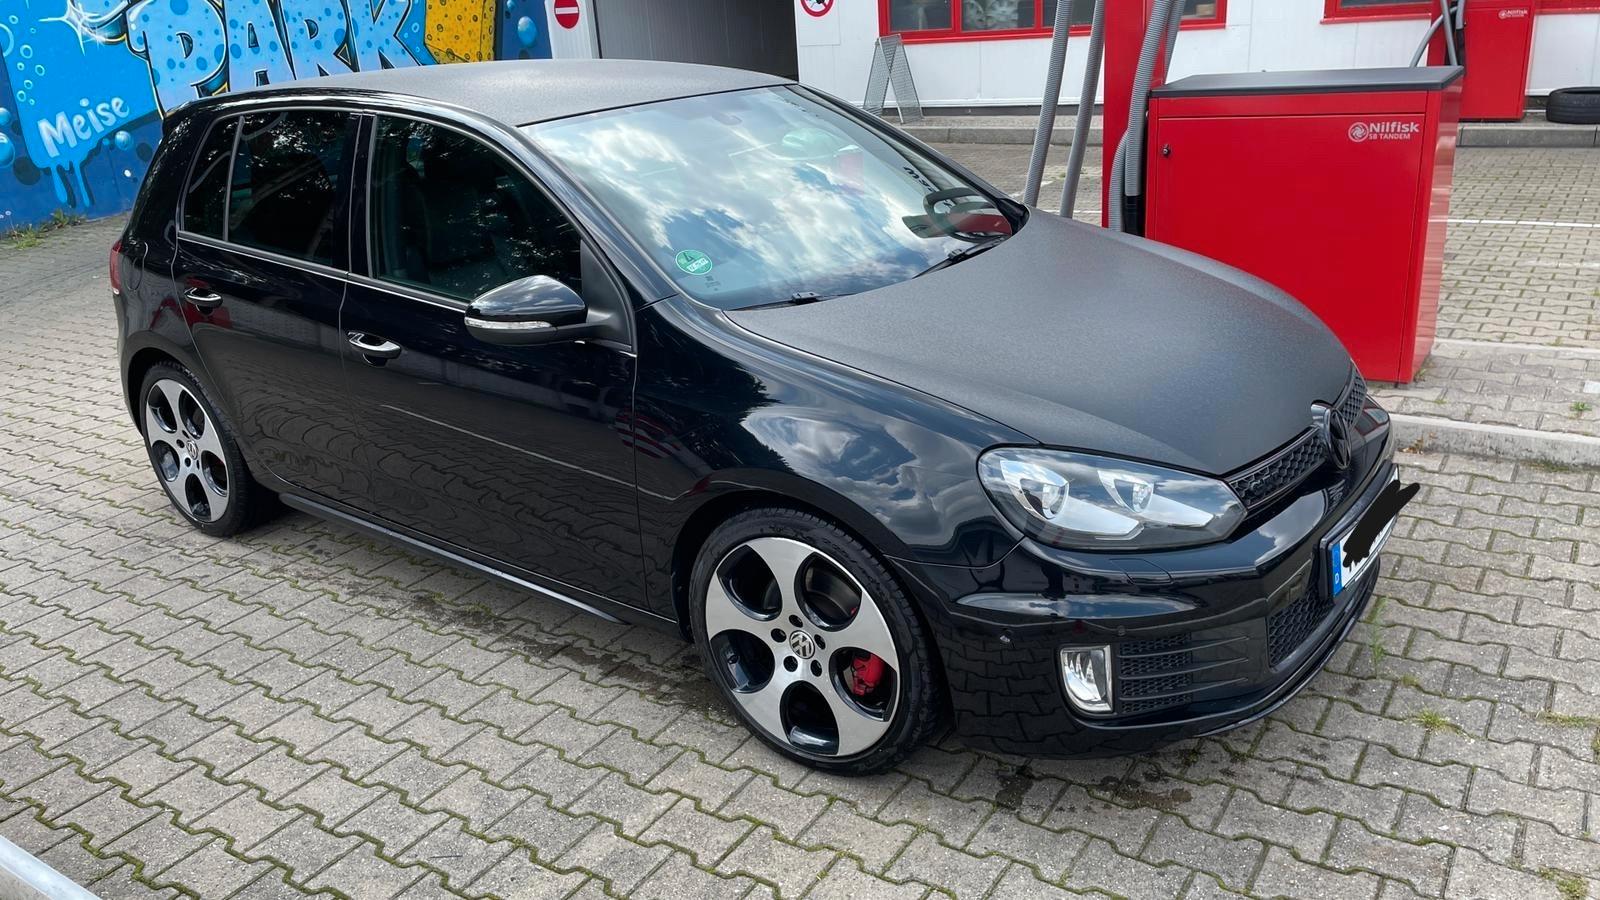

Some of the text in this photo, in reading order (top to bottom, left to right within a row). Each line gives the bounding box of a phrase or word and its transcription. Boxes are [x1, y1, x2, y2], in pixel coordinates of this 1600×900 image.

[127, 0, 423, 111] PARK
[37, 97, 129, 158] Meise
[1369, 121, 1420, 133] Nilfisk
